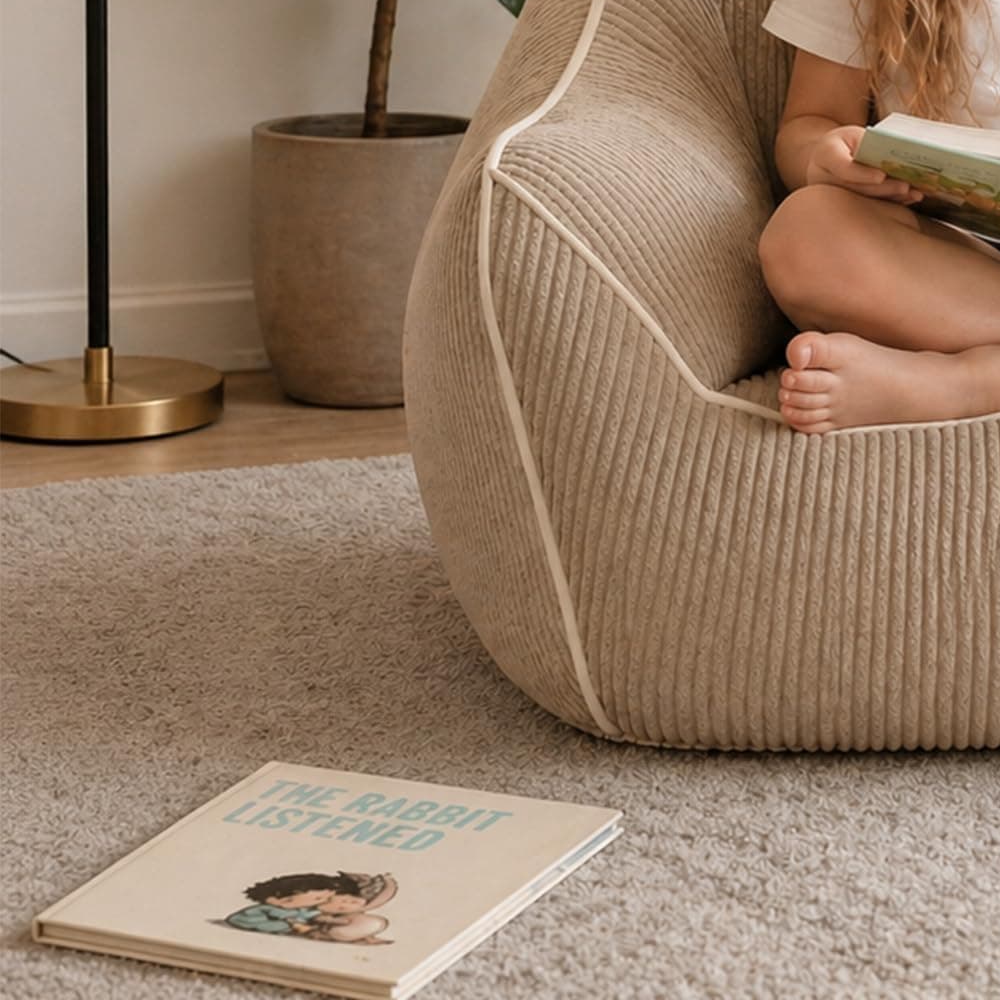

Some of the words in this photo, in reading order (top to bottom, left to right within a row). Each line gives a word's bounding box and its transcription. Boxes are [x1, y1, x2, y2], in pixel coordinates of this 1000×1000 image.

[222, 801, 446, 851] LISTENED
[258, 779, 347, 809] THE
[341, 791, 513, 831] RABBIT
